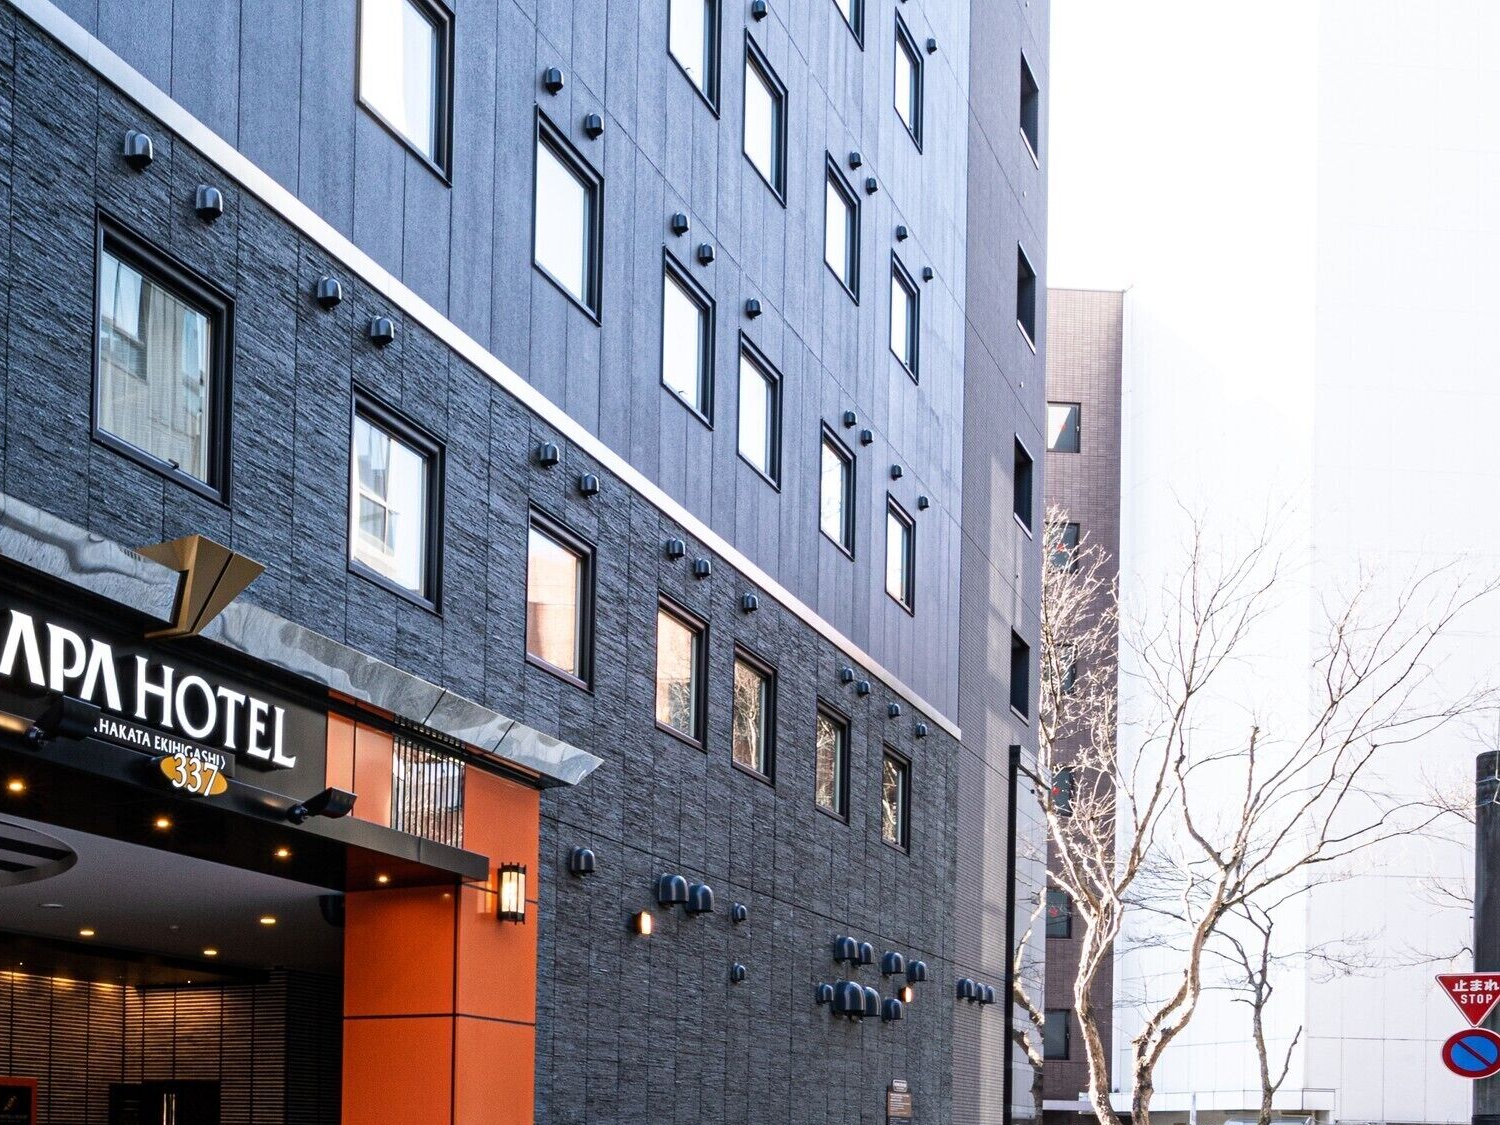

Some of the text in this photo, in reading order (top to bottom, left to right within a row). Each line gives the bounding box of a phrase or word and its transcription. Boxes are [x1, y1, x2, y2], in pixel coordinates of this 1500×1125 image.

[134, 654, 296, 768] HOTEL
[172, 753, 219, 797] 337
[1452, 979, 1499, 992] 止まれ
[1460, 994, 1493, 1004] STOP
